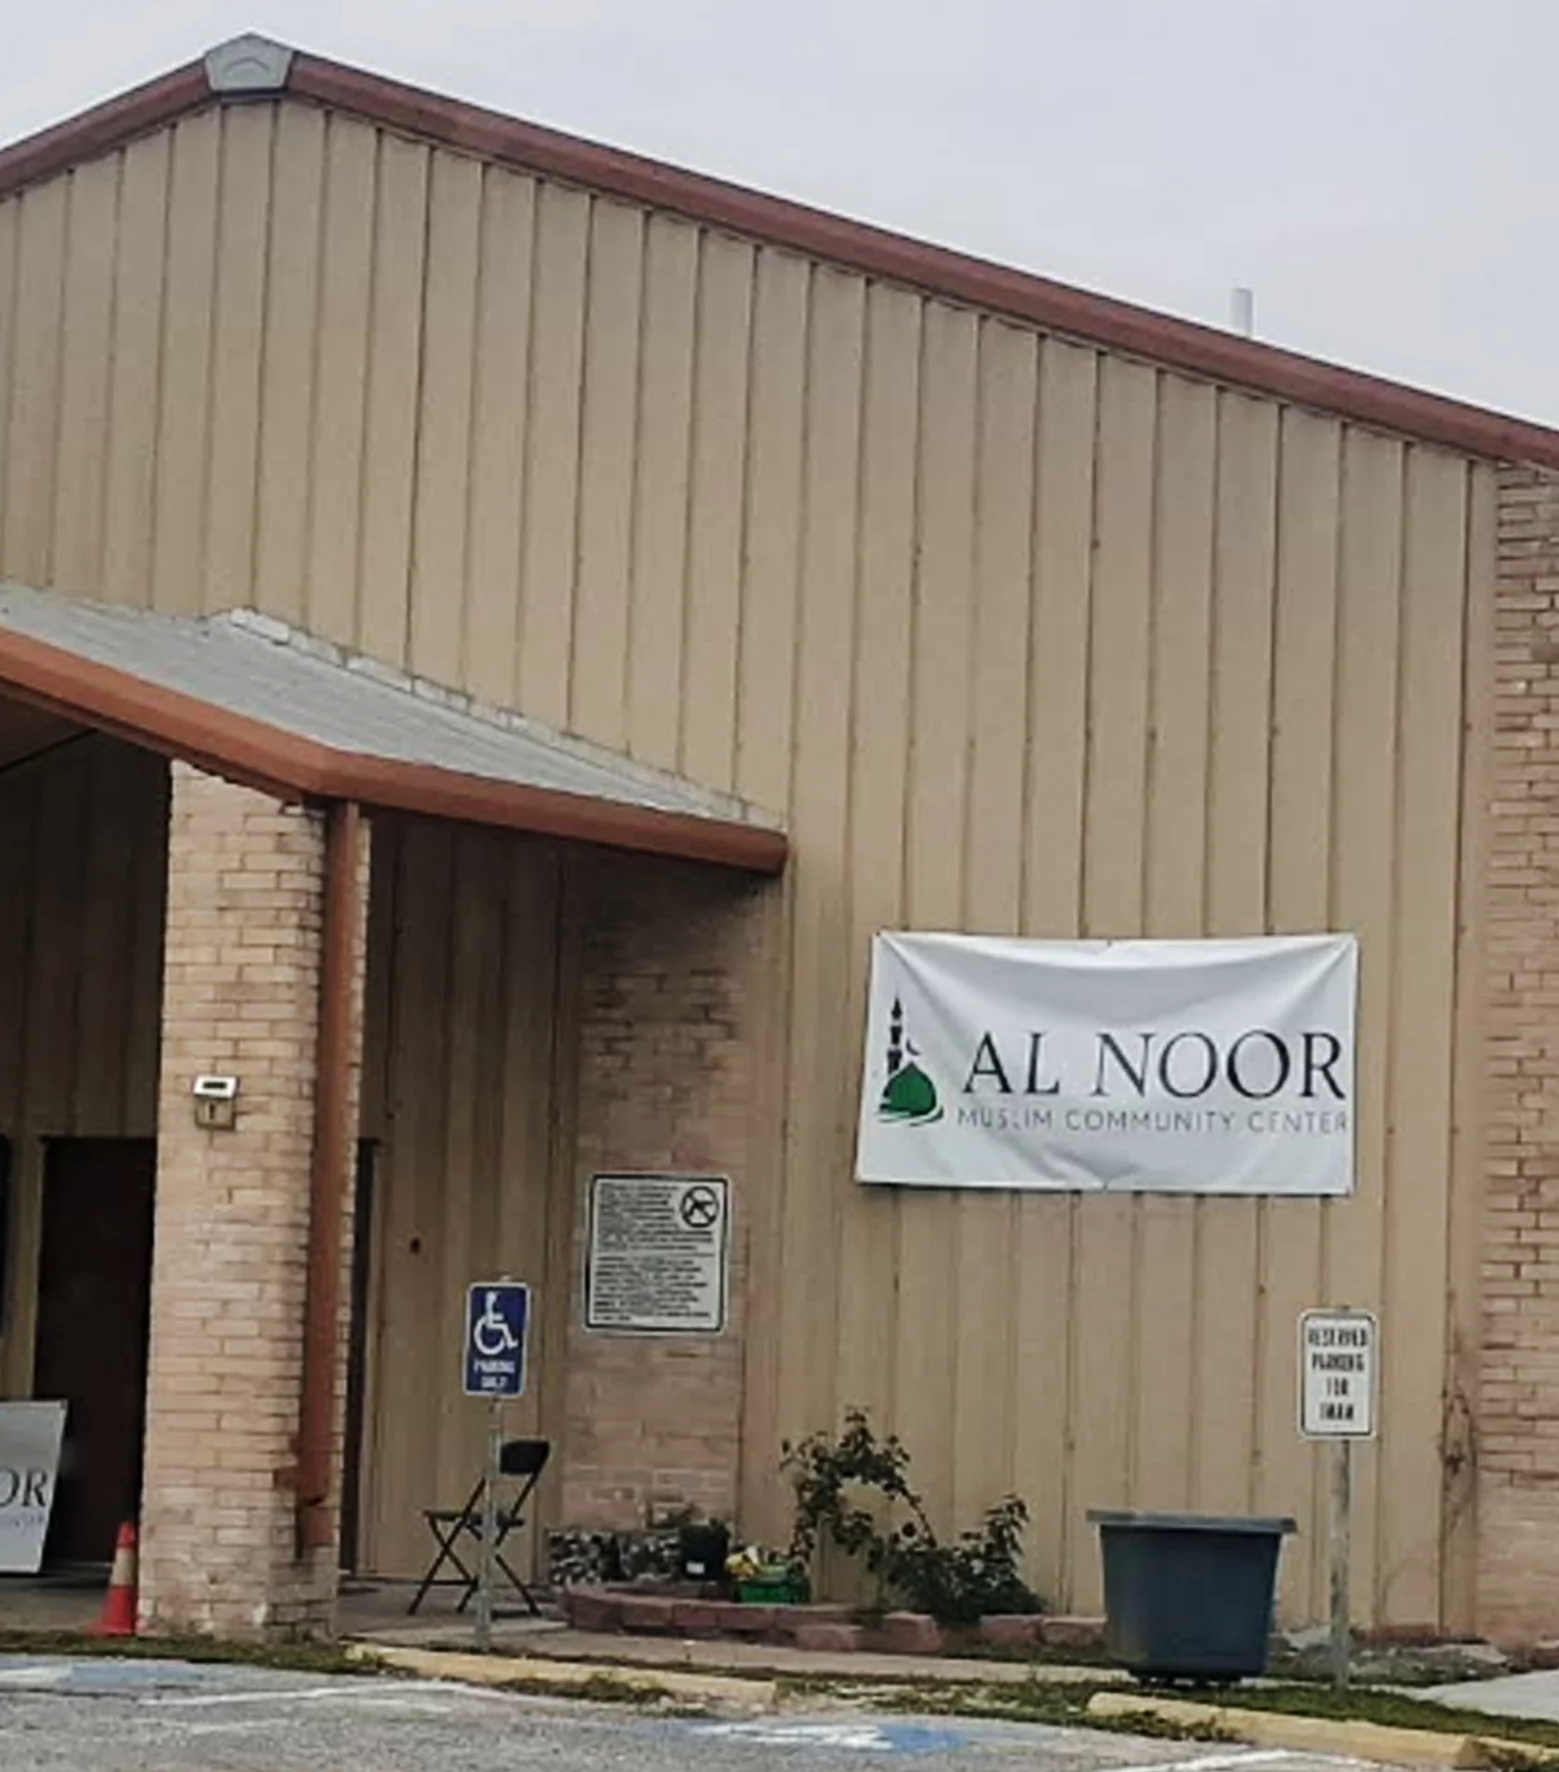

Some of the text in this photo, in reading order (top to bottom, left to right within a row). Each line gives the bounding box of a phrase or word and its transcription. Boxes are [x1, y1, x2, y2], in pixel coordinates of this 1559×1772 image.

[963, 1029, 1347, 1099] AL NOOR
[957, 1107, 1347, 1133] MUSLIM COMMUNITY CENTER
[1308, 1328, 1368, 1346] RESERVED
[1312, 1352, 1365, 1371] PARKING
[1326, 1376, 1349, 1396] FOR
